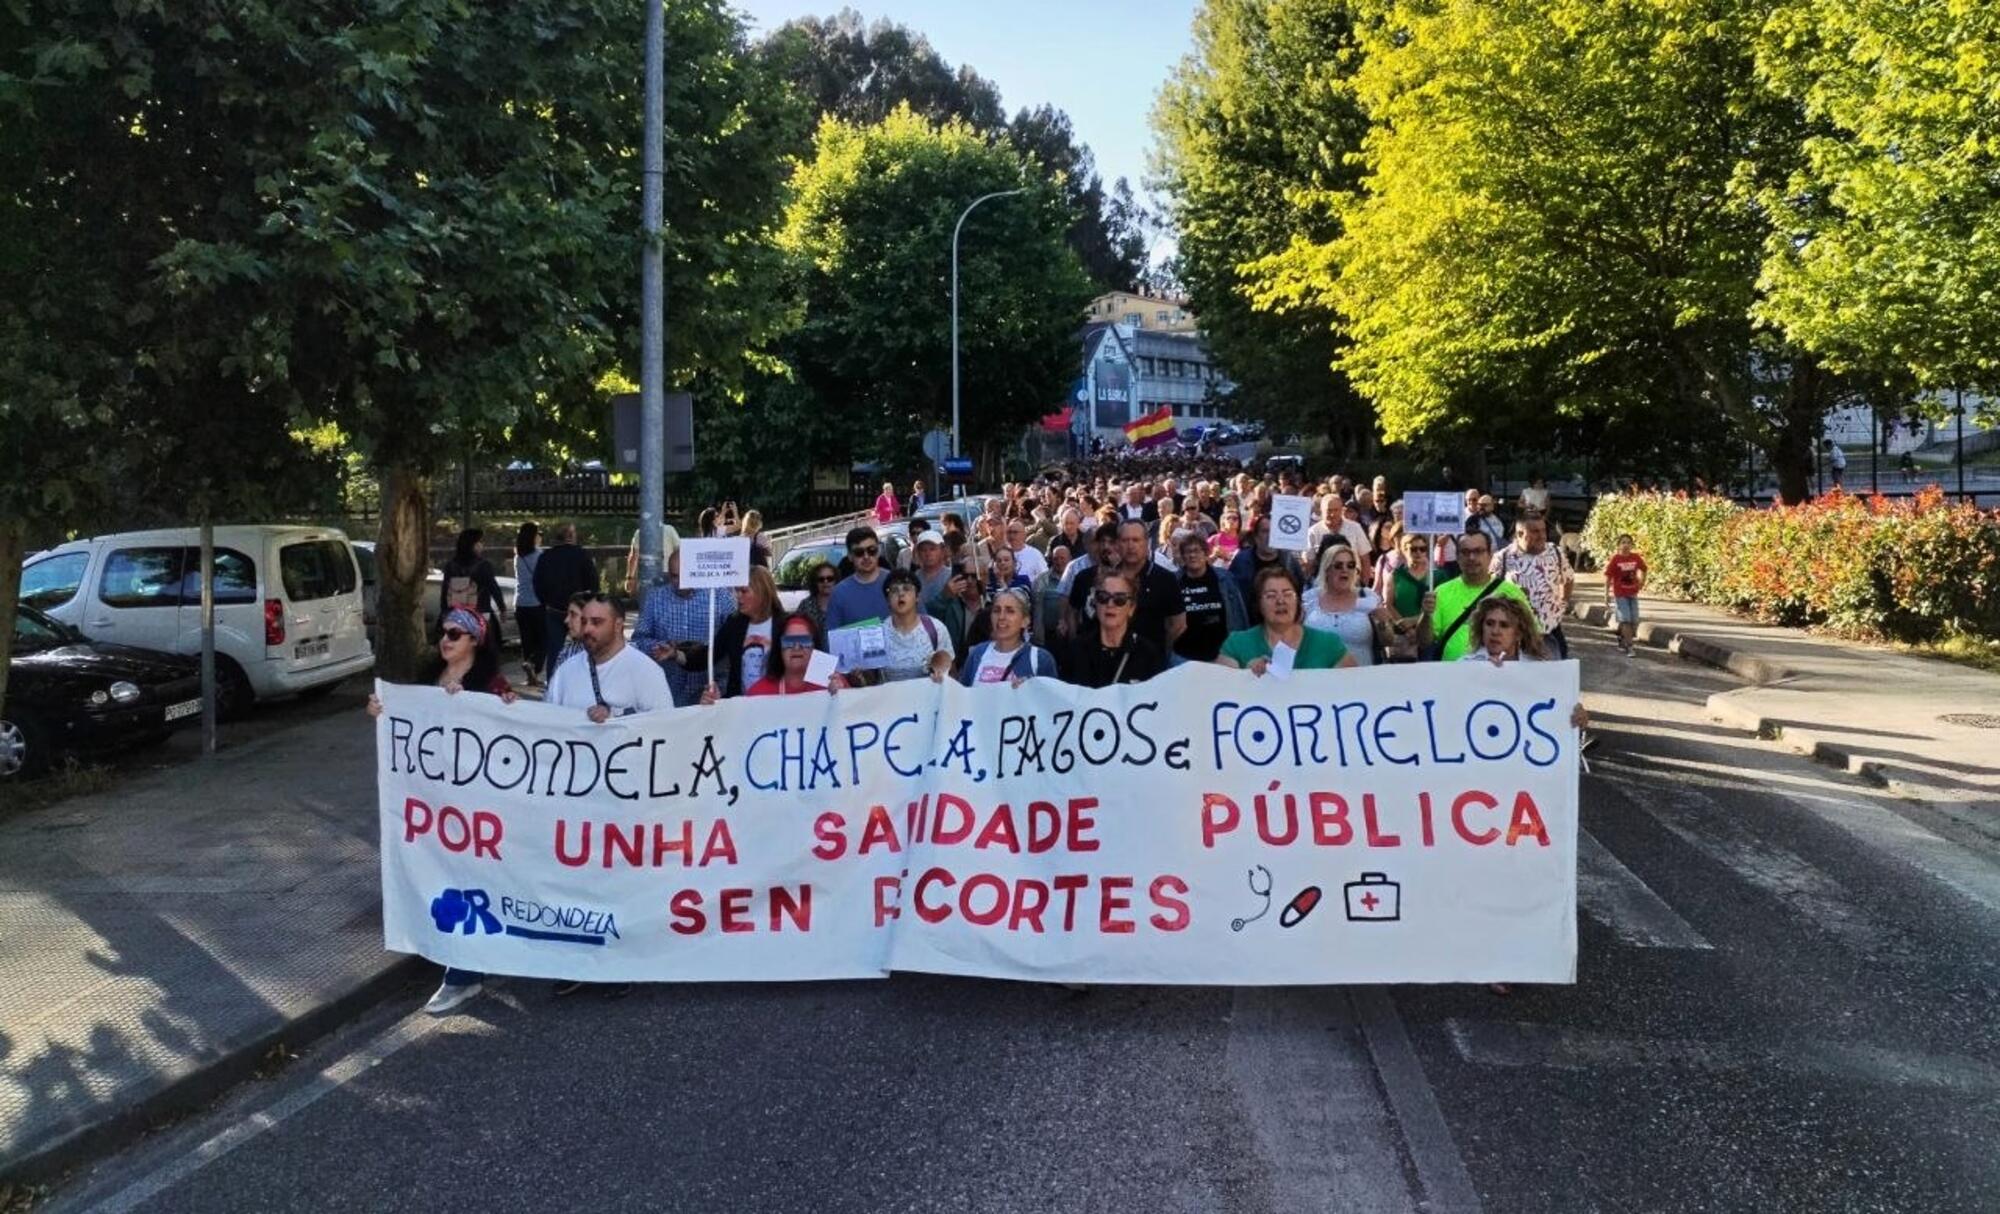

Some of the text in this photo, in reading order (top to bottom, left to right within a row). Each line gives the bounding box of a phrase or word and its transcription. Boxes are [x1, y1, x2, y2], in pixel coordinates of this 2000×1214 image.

[1212, 697, 1561, 770] FORNELOS
[403, 797, 503, 861] POR
[554, 817, 738, 869] UNHA
[1202, 779, 1552, 848] PÚBLICA
[501, 896, 621, 940] REDONDELA
[669, 883, 813, 935] SEN
